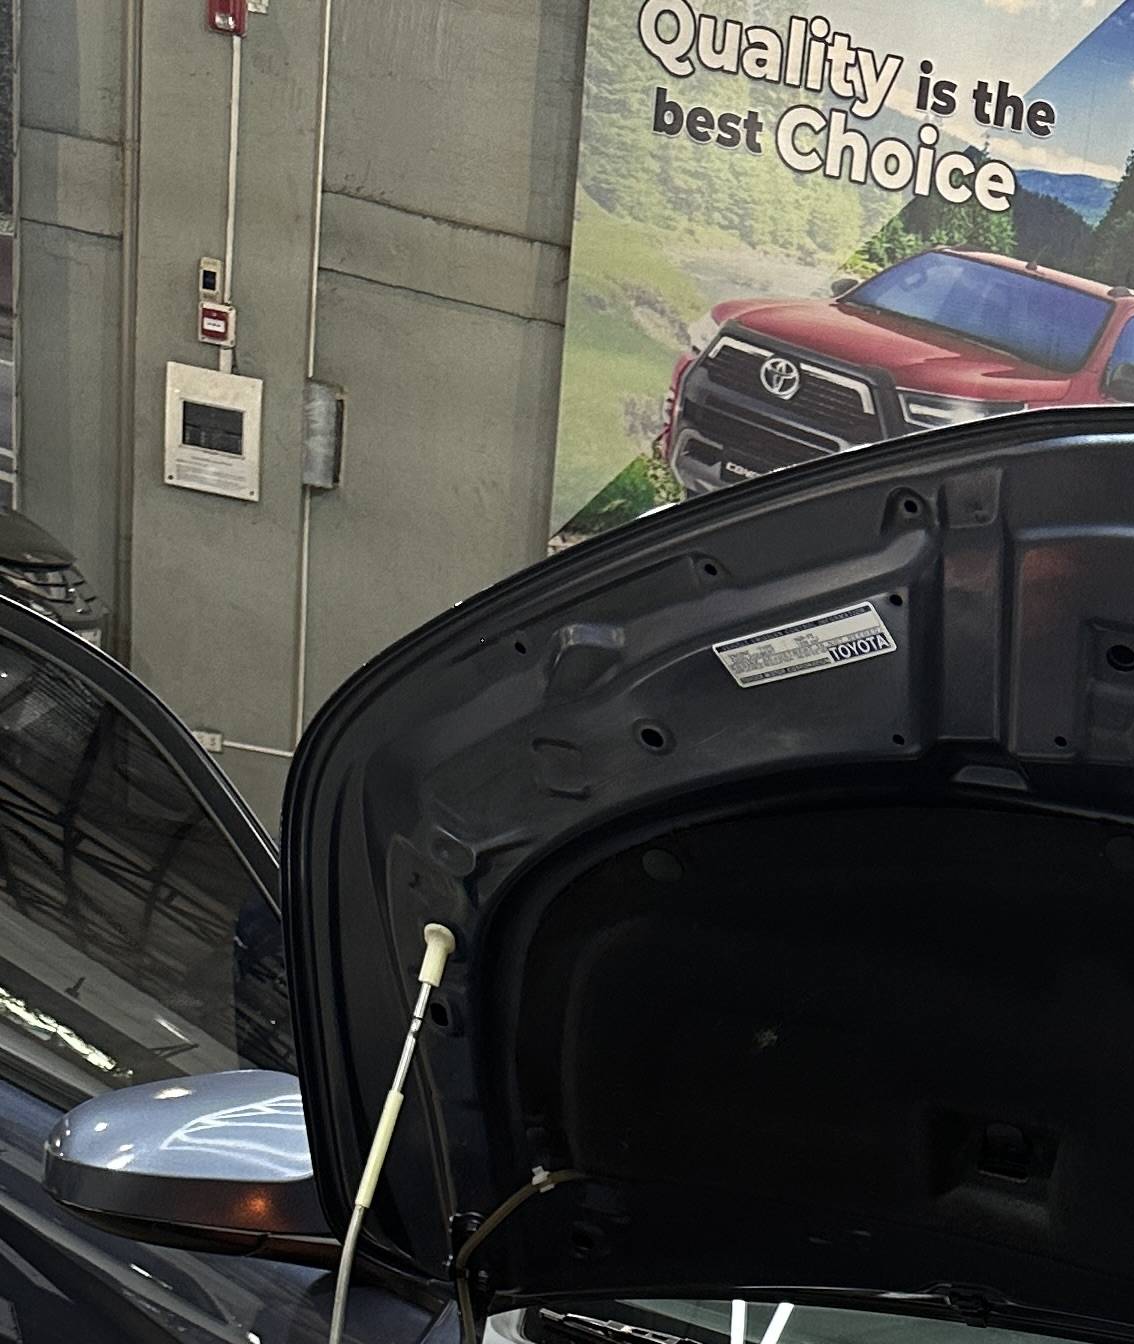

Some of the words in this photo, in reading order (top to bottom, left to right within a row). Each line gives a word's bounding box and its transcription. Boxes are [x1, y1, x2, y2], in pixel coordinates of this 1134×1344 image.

[638, 0, 904, 119] Quality
[916, 60, 958, 115] is
[973, 80, 1055, 137] the
[653, 87, 763, 153] best
[775, 104, 1016, 212] Choice
[829, 636, 890, 661] TOYOTA
